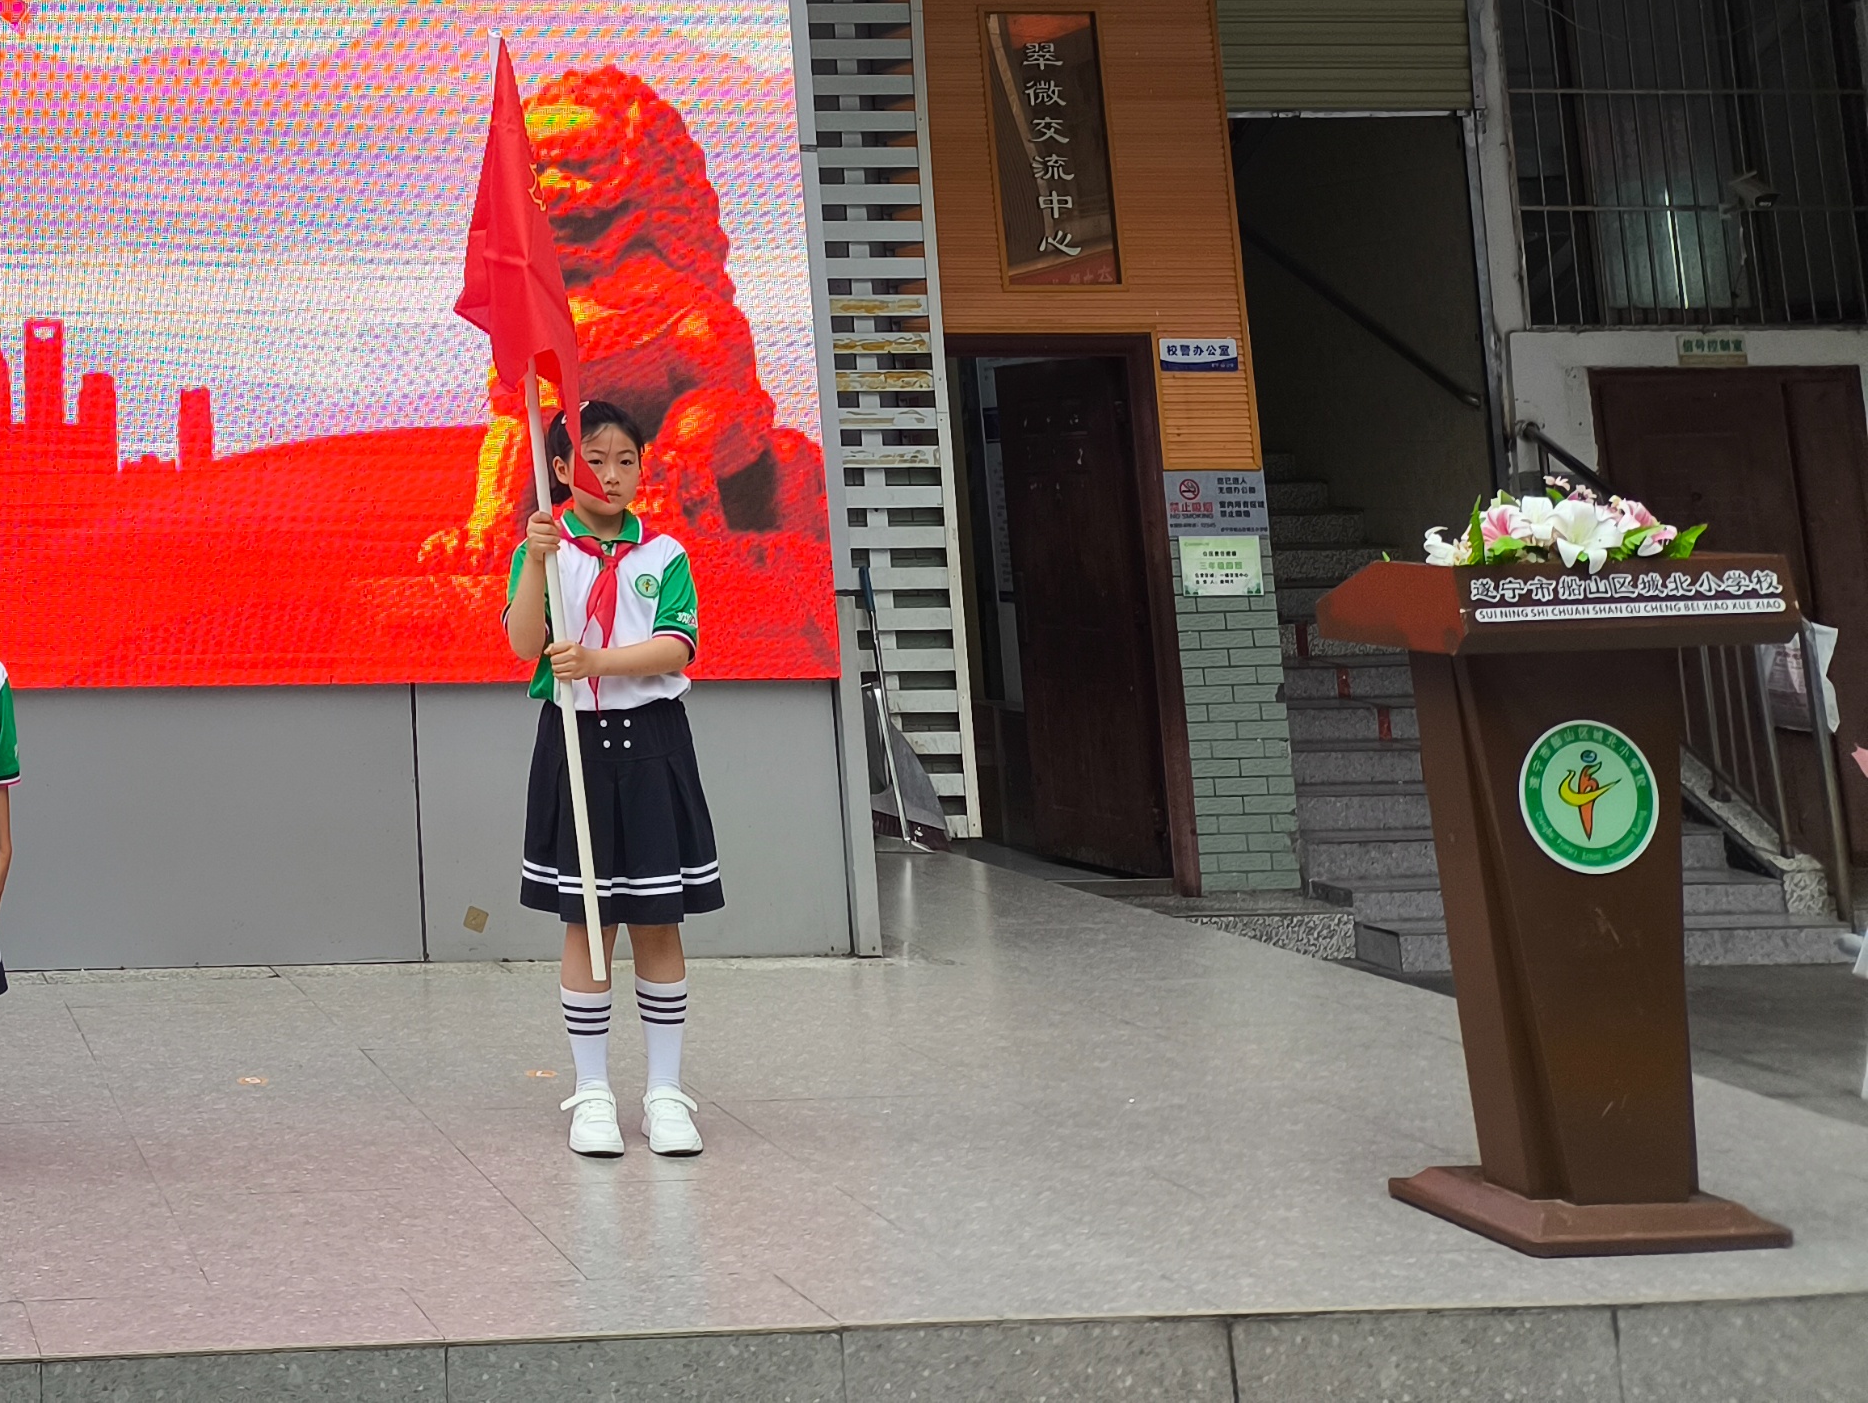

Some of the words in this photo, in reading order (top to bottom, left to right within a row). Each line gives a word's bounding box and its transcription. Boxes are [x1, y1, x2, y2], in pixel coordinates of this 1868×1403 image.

[1023, 42, 1082, 256] 翠微交流中心
[1166, 344, 1231, 357] 校警办公室
[1170, 502, 1213, 513] 禁止吸烟
[1470, 570, 1783, 603] 遂宁市船山区城北小学校
[1479, 610, 1497, 620] SUI
[1500, 609, 1529, 619] NING
[1531, 608, 1549, 618] SHI
[1551, 606, 1590, 617] CHUAN
[1592, 604, 1623, 615] SHAN
[1626, 604, 1641, 614] QU
[1644, 602, 1681, 613] CHENG
[1684, 601, 1699, 611] BEI
[1703, 601, 1729, 611] XIAO
[1732, 600, 1752, 610] XUE
[1755, 600, 1781, 610] XIAO
